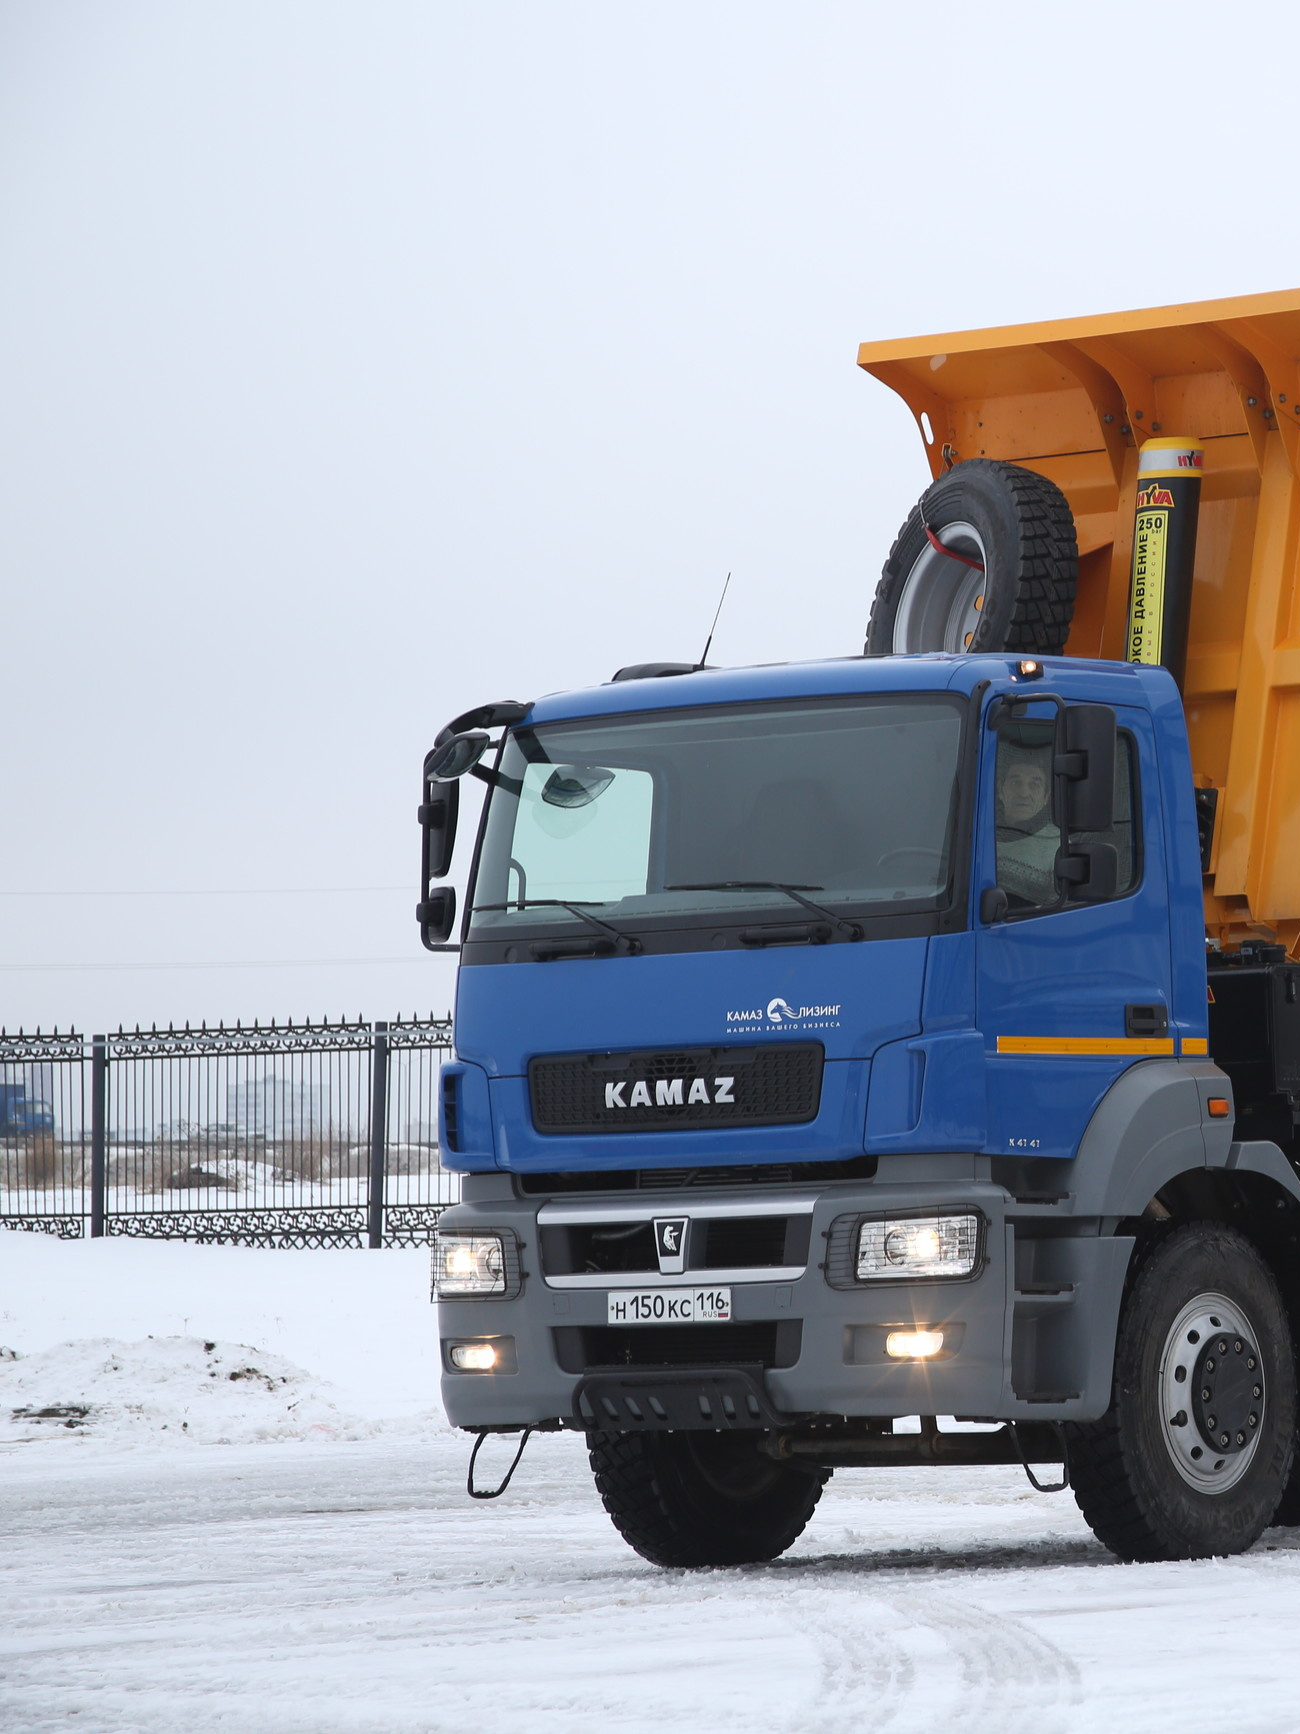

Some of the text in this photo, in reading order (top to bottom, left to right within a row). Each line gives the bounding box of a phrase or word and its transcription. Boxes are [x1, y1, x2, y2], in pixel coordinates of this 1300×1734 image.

[1137, 484, 1173, 507] HYVA
[1138, 517, 1163, 531] 250
[1135, 533, 1148, 619] ДАВЛЕНИЕ
[726, 1005, 841, 1021] КАМАЗ ЛИЗИНГ
[766, 1024, 798, 1032] ВАШЕГО
[803, 1021, 841, 1029] БИЗНЕСА
[605, 1077, 735, 1108] KAMAZ
[696, 1292, 725, 1310] 116
[703, 1310, 718, 1318] RUS
